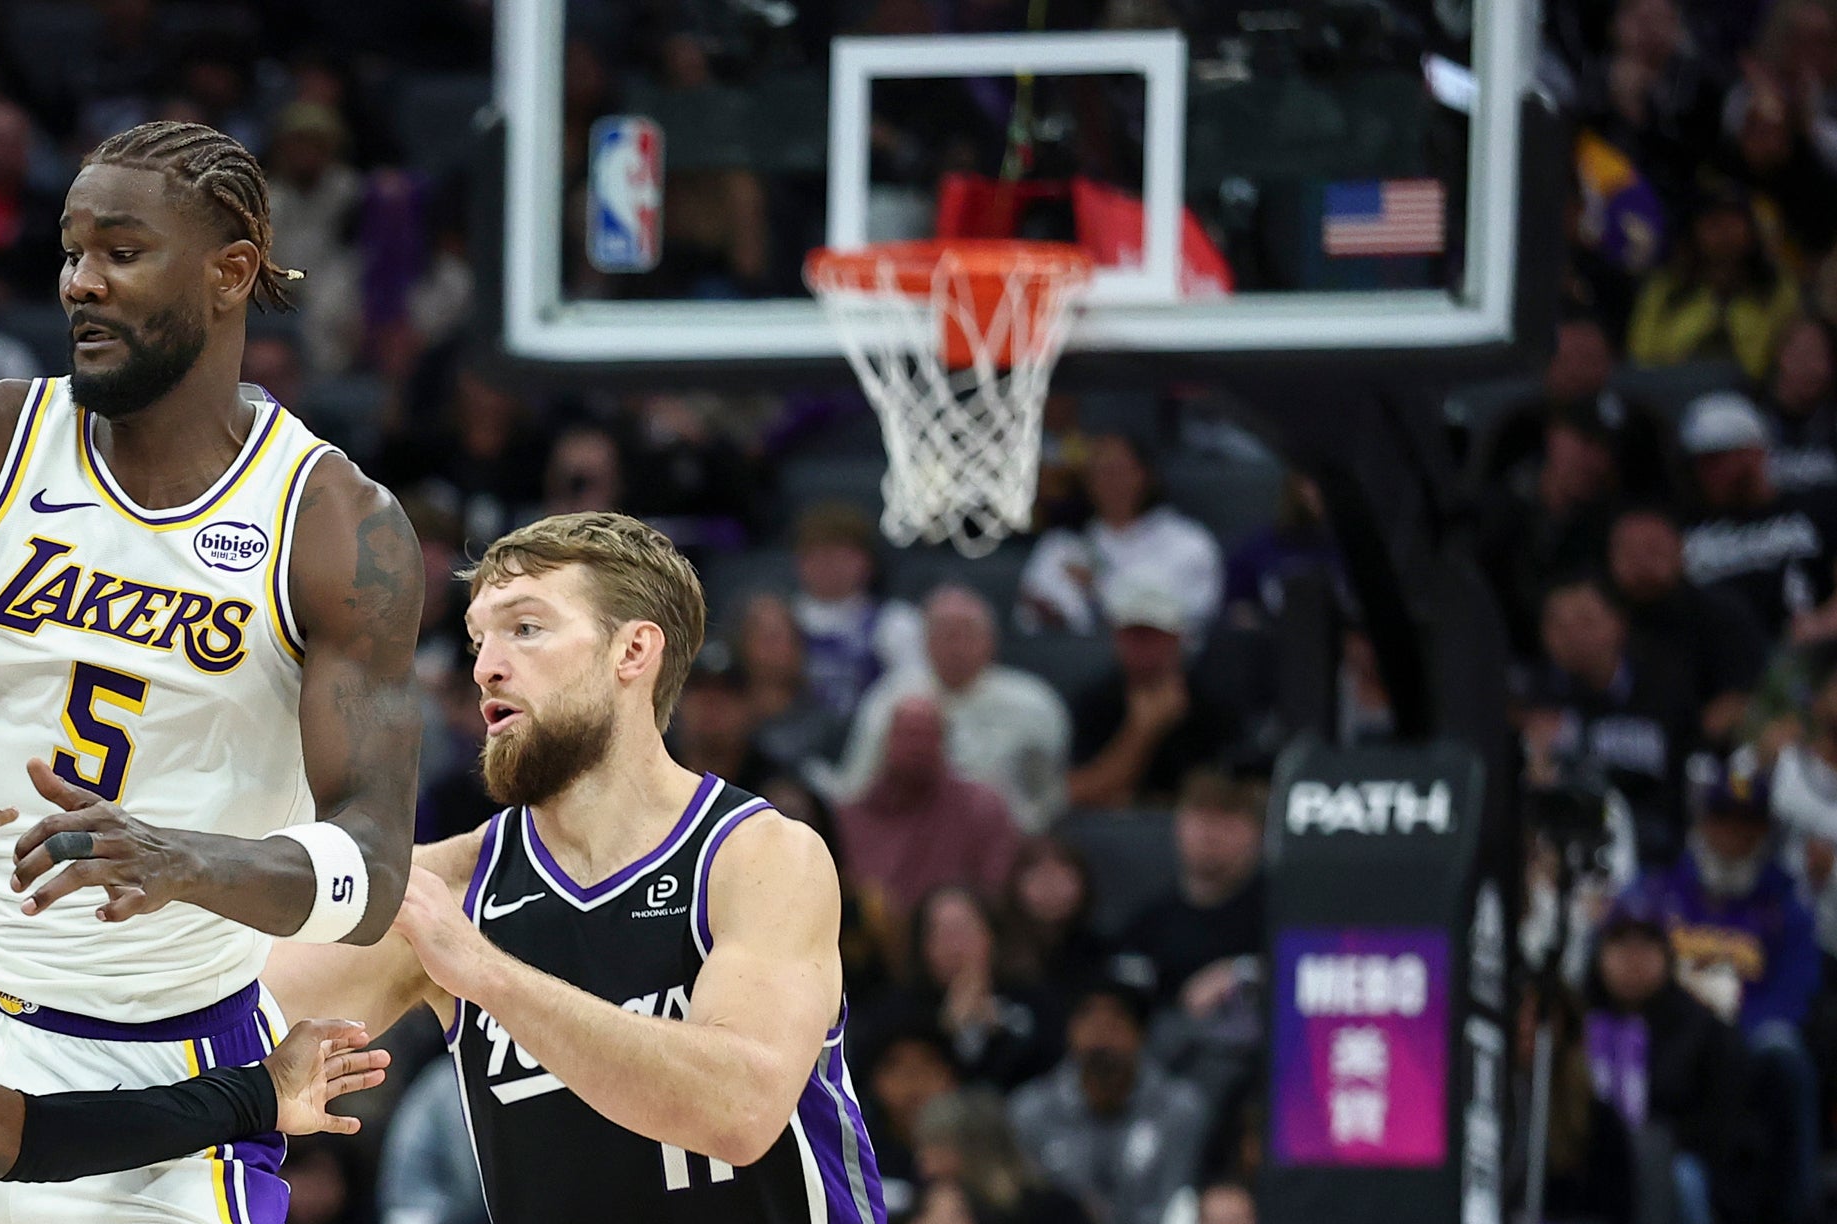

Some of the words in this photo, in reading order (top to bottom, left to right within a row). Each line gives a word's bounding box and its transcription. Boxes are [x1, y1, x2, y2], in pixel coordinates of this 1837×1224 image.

[201, 533, 264, 559] bibigo
[50, 660, 151, 806] 5
[1285, 779, 1452, 834] PATH
[631, 907, 668, 919] PHOONG
[669, 904, 687, 915] LAW
